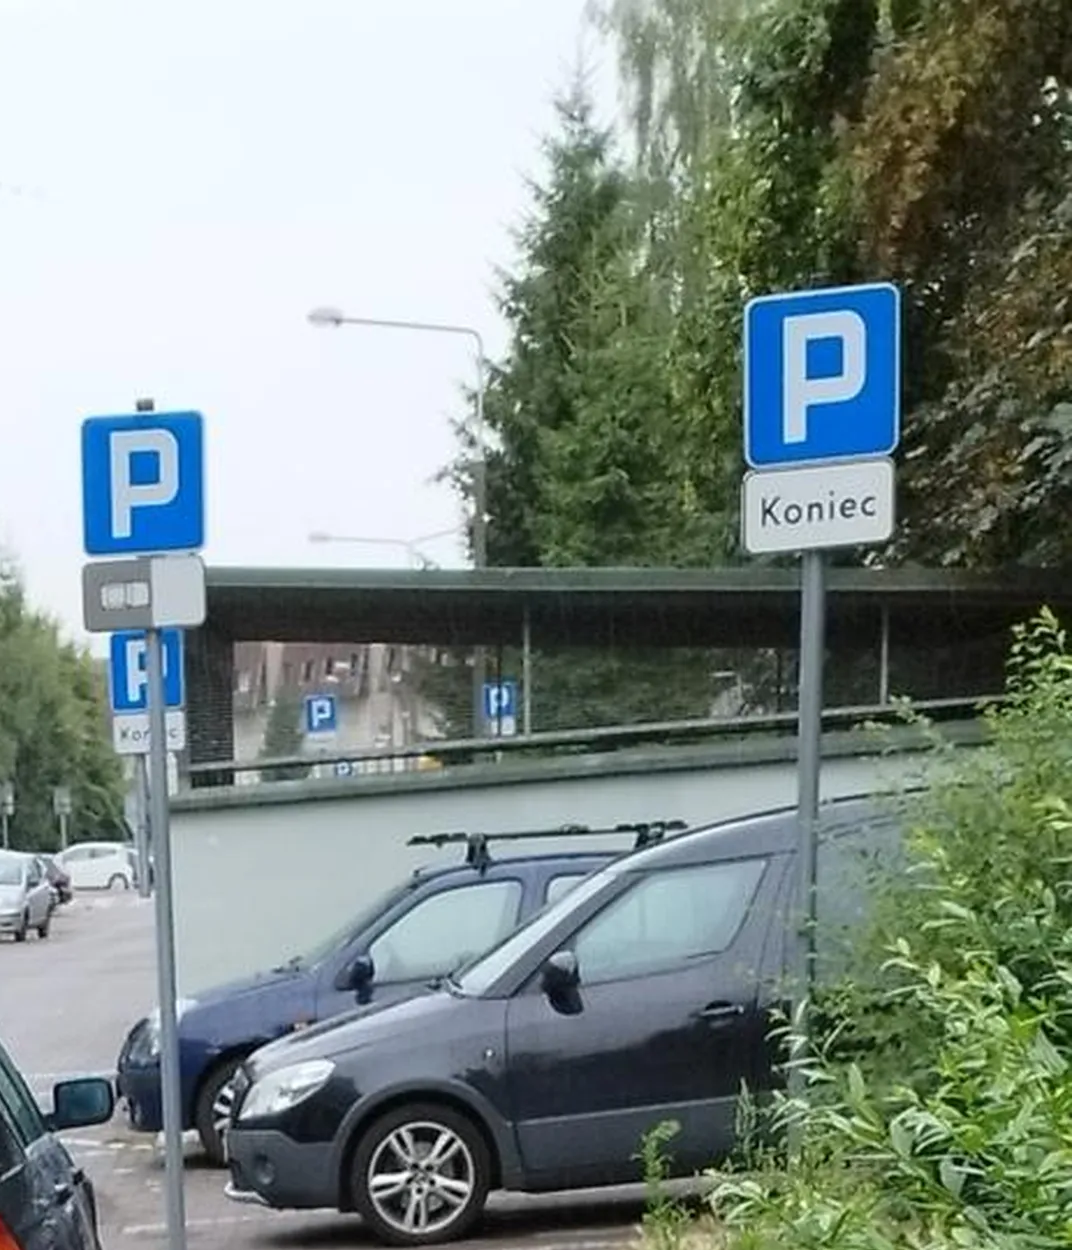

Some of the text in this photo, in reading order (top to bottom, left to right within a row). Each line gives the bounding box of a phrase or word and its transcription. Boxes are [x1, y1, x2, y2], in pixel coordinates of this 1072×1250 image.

[782, 309, 867, 445] P
[108, 427, 179, 539] P
[761, 490, 877, 527] Koniec
[311, 700, 331, 729] P
